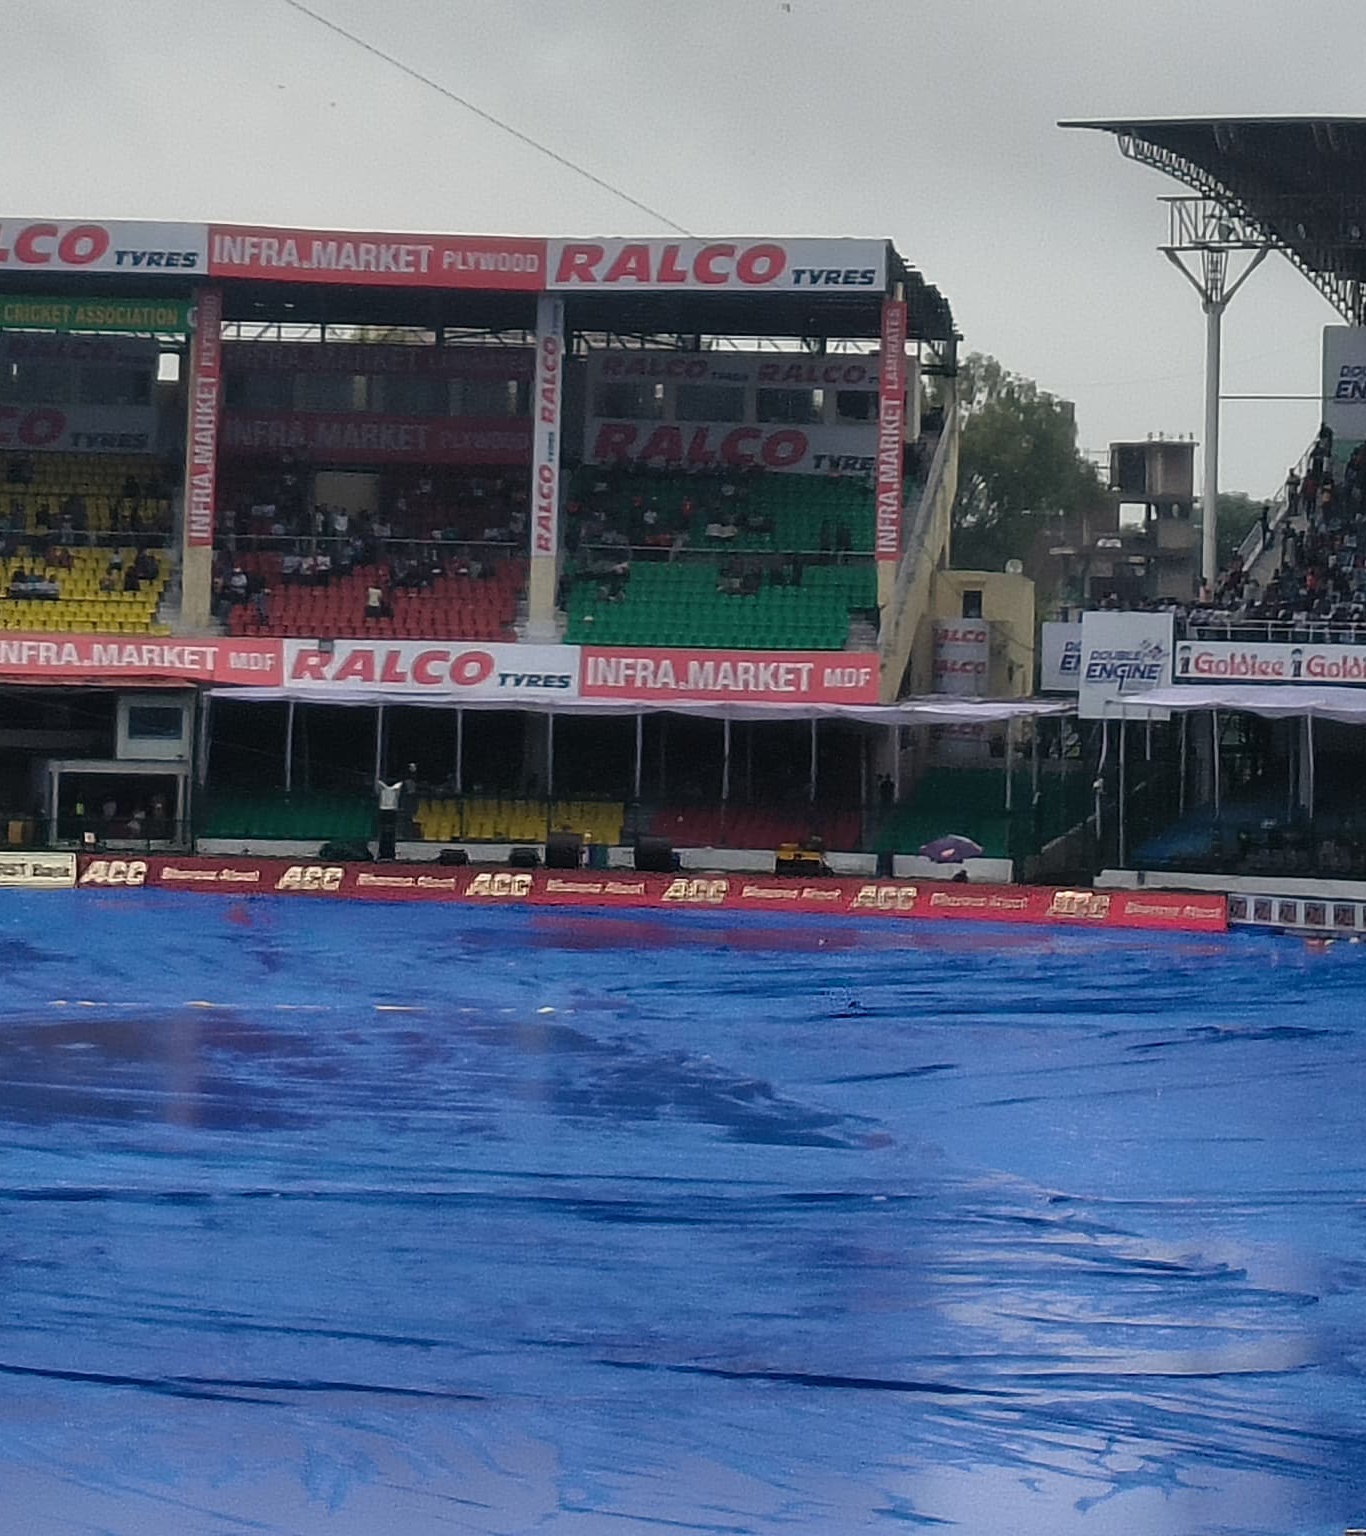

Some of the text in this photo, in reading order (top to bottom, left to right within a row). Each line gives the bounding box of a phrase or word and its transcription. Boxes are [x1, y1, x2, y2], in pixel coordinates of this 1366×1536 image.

[115, 250, 199, 268] TYRES
[212, 234, 539, 273] INFRA.MARKET PLYWOOD
[555, 244, 876, 285] RALCO TYRES
[5, 303, 72, 323] CRICKET
[75, 306, 178, 325] ASSOCIATION
[540, 336, 557, 424] RALCO
[593, 423, 809, 467] RALCO
[877, 308, 902, 553] INFRA.MARKET LAMINATES
[189, 377, 216, 539] INFRA.MARKET
[537, 464, 555, 552] RALCO
[939, 630, 987, 643] ALCO
[1090, 650, 1142, 662] DOUBLE
[229, 651, 275, 671] MDF
[290, 649, 571, 688] RALCO TYRES
[586, 657, 871, 692] INFRA.MARKET MDF
[1085, 662, 1162, 684] ENGINE
[1194, 650, 1284, 677] Goldiee
[80, 861, 147, 885] ACC
[275, 866, 346, 890] ACC
[465, 873, 533, 897] ACC
[661, 878, 729, 904] ACC
